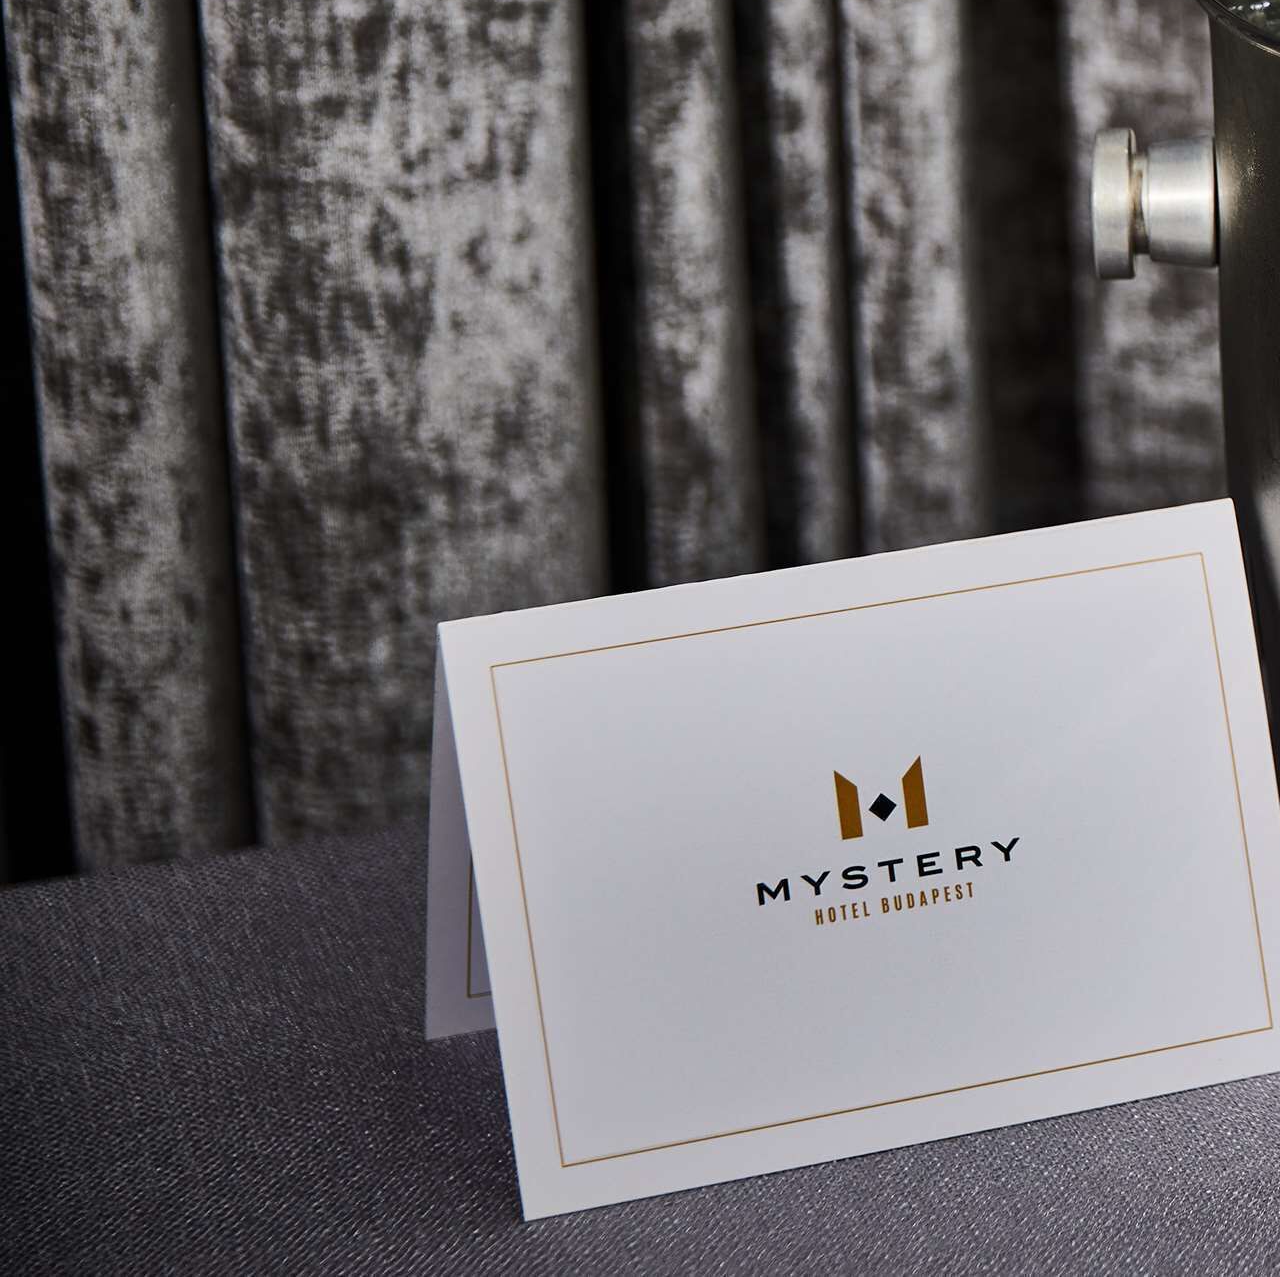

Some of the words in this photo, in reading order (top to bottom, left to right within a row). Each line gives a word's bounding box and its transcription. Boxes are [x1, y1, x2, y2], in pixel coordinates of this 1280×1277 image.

[756, 837, 1020, 906] MYSTERY
[815, 901, 871, 926] HOTEL
[881, 881, 974, 914] BUDAPEST
